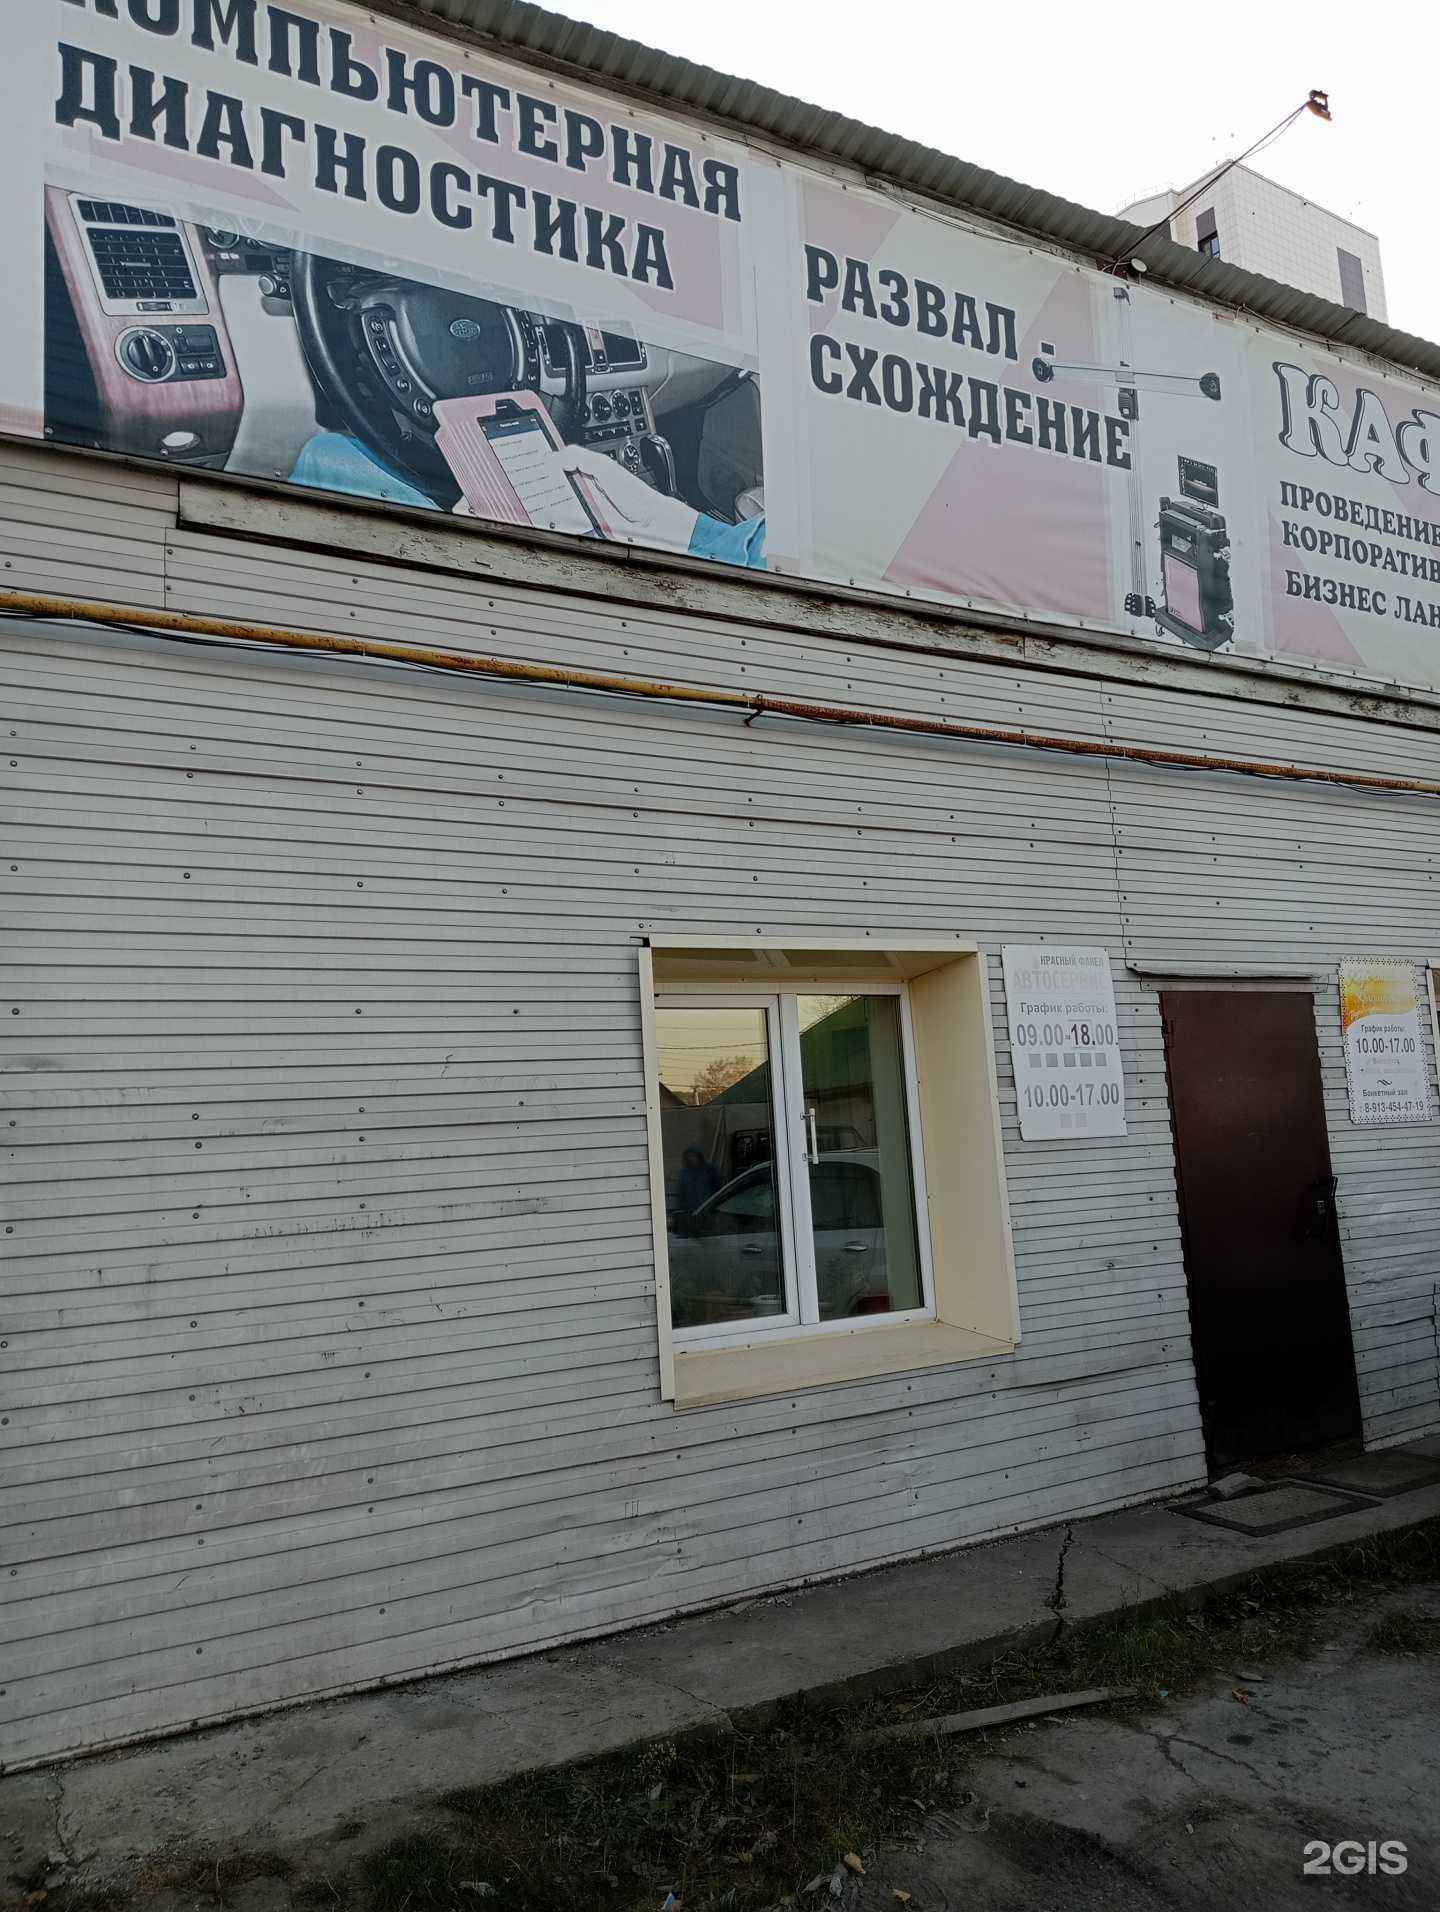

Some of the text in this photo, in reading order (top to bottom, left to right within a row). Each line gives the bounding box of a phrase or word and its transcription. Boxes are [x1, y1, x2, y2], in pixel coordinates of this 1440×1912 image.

[62, 0, 741, 221] ОМПЬЮТЕРНАЯ
[55, 42, 674, 290] ДИАГНОСТИКА
[804, 245, 1018, 360] РАЗВАЛ
[809, 335, 1131, 470] СХОЖДЕНИЕ
[1285, 570, 1386, 615] БИЗНЕС
[1020, 1002, 1062, 1015] График
[1356, 1038, 1415, 1054] 10.00-17.00
[1024, 1083, 1119, 1108] 10.00-17.00
